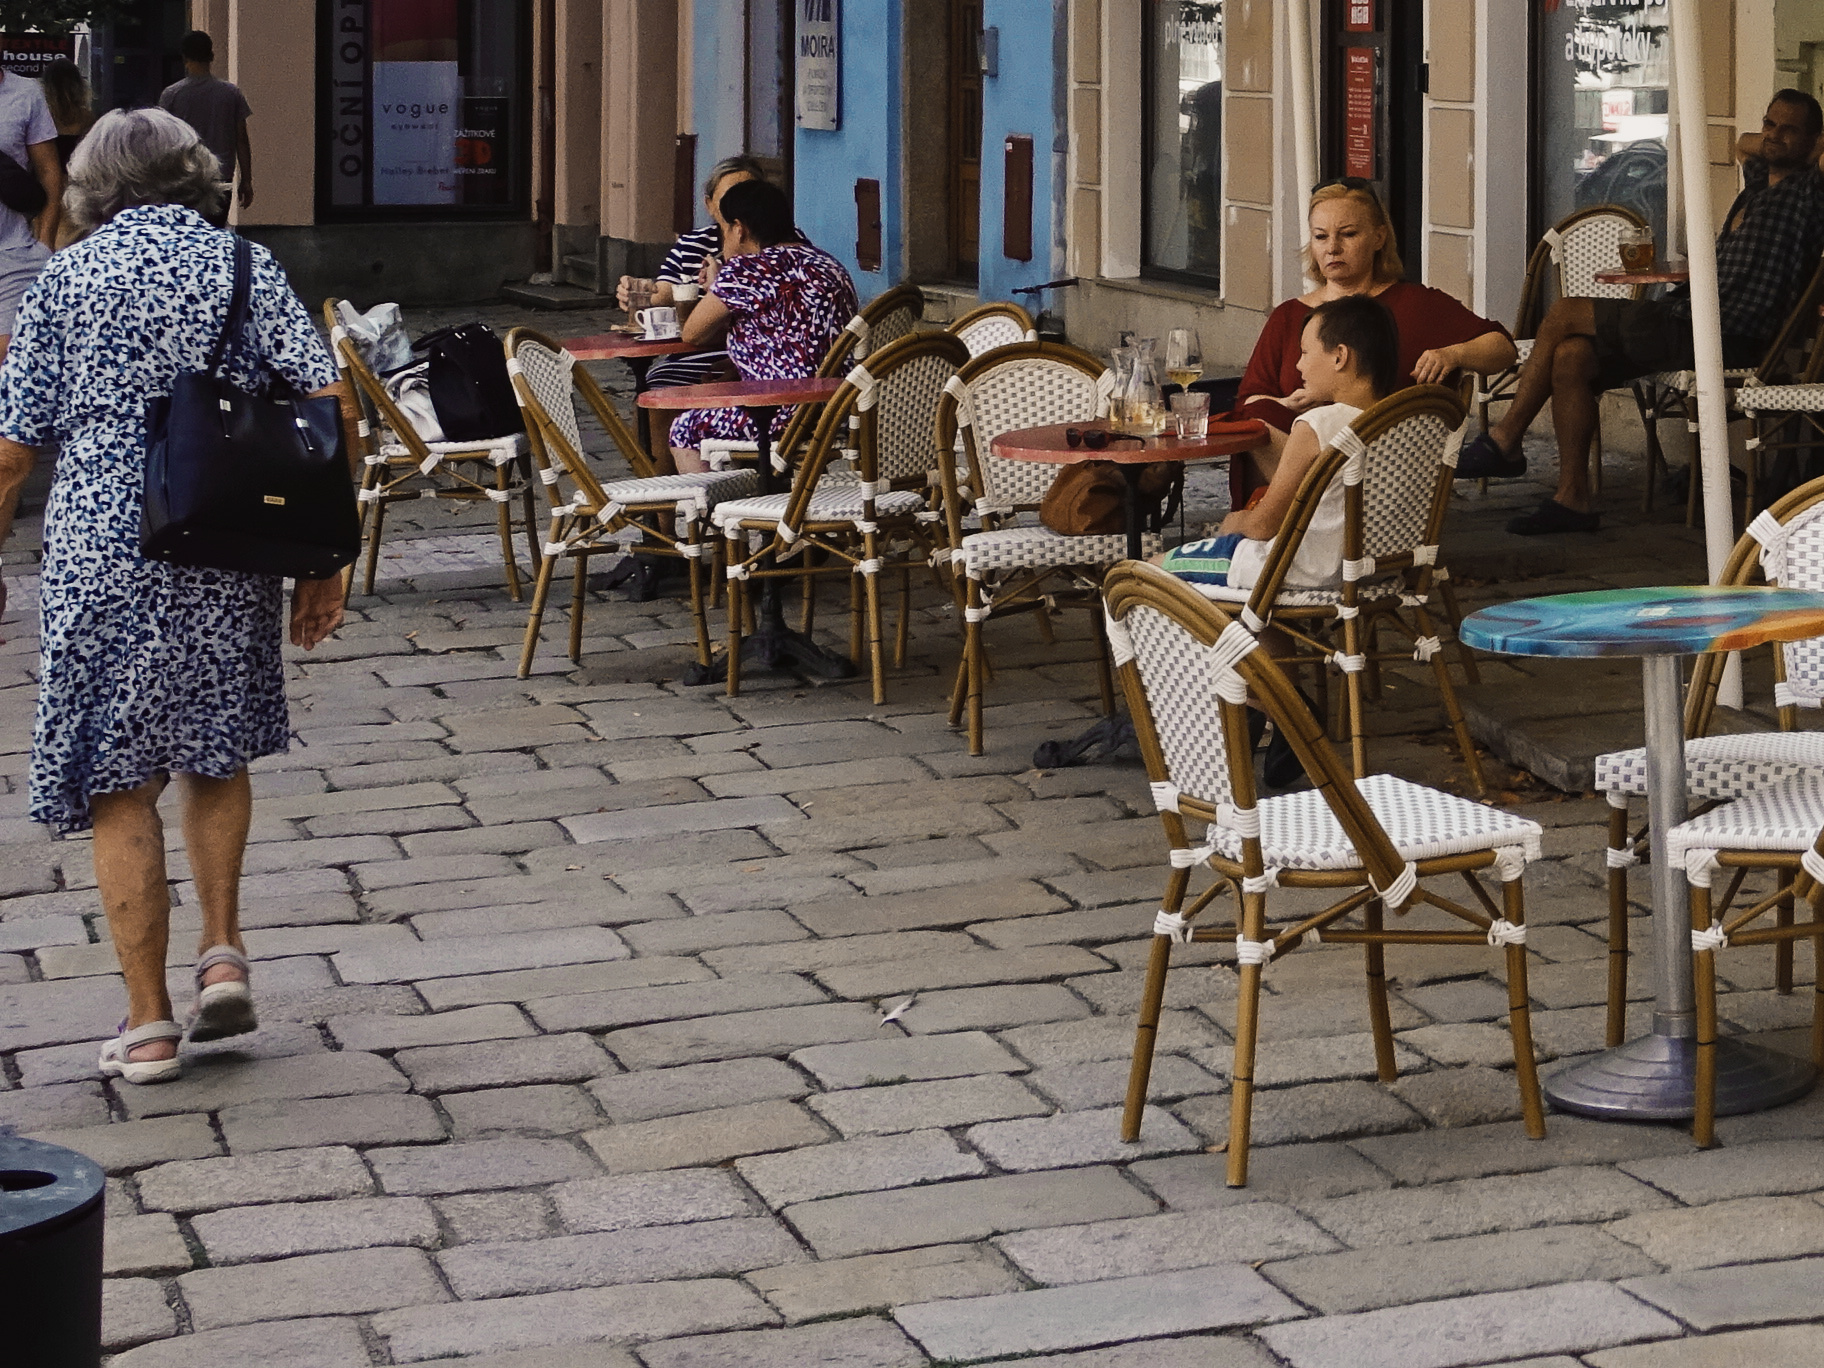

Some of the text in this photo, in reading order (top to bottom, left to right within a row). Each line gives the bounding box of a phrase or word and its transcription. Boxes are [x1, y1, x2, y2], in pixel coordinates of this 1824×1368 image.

[3, 50, 67, 63] house
[801, 34, 836, 59] MOIRA
[382, 103, 449, 119] vogue
[331, 78, 363, 177] OČNÍ
